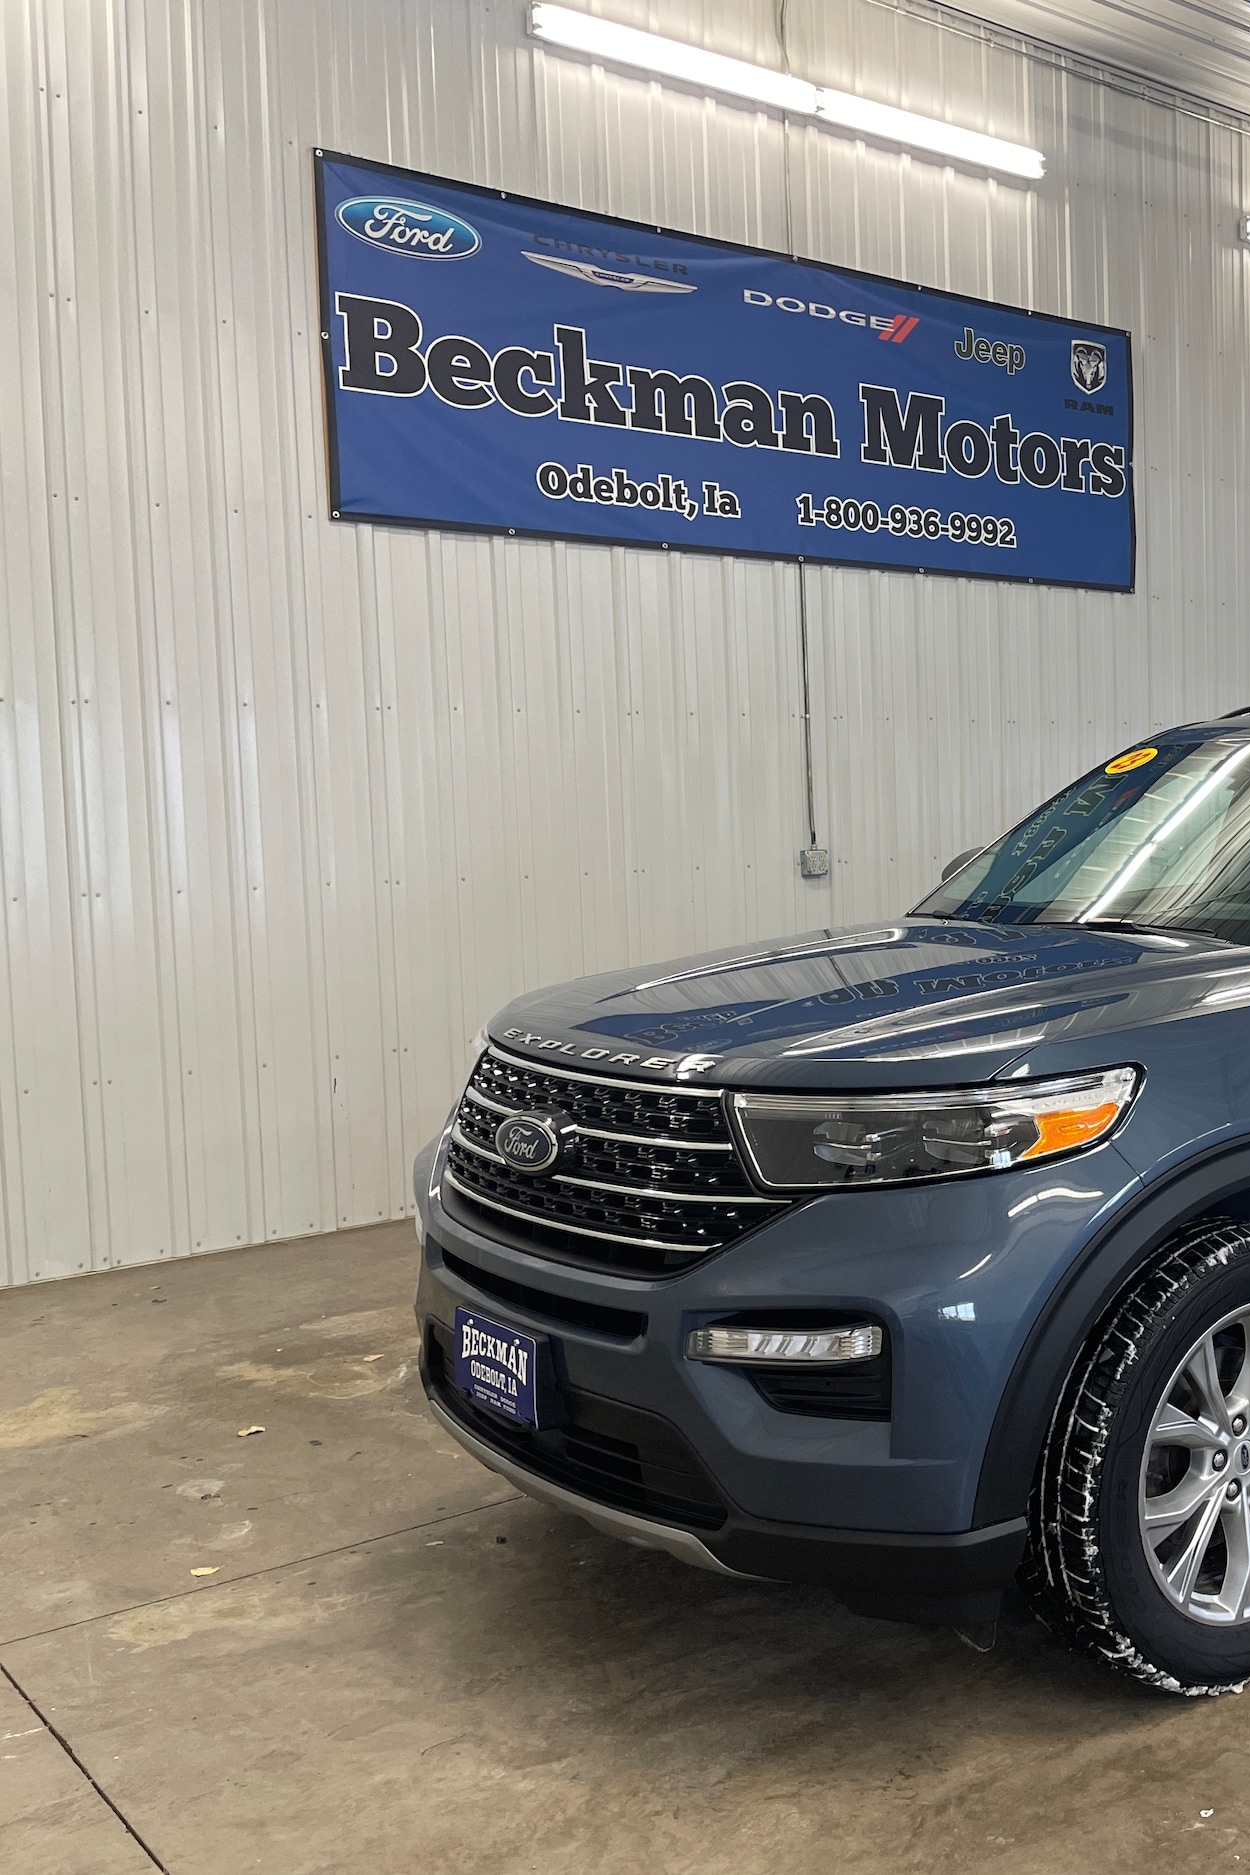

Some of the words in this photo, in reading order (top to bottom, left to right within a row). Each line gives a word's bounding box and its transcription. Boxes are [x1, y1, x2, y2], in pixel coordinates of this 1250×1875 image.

[364, 203, 455, 254] Ford
[533, 233, 688, 276] CHRYSLER
[743, 288, 895, 332] DODGE
[954, 327, 1026, 375] Jeep
[335, 291, 840, 459] Beckman
[859, 383, 1126, 497] Motors
[1065, 398, 1114, 417] RAM
[536, 461, 698, 521] Odebolt,
[703, 481, 741, 519] Ia
[796, 493, 1017, 548] 1-800-936-9992
[502, 1027, 717, 1074] EXPLORER
[503, 1126, 539, 1161] Ford
[461, 1324, 528, 1386] BECKMAN
[470, 1359, 507, 1394] ODEBOLT,
[507, 1377, 518, 1397] IA
